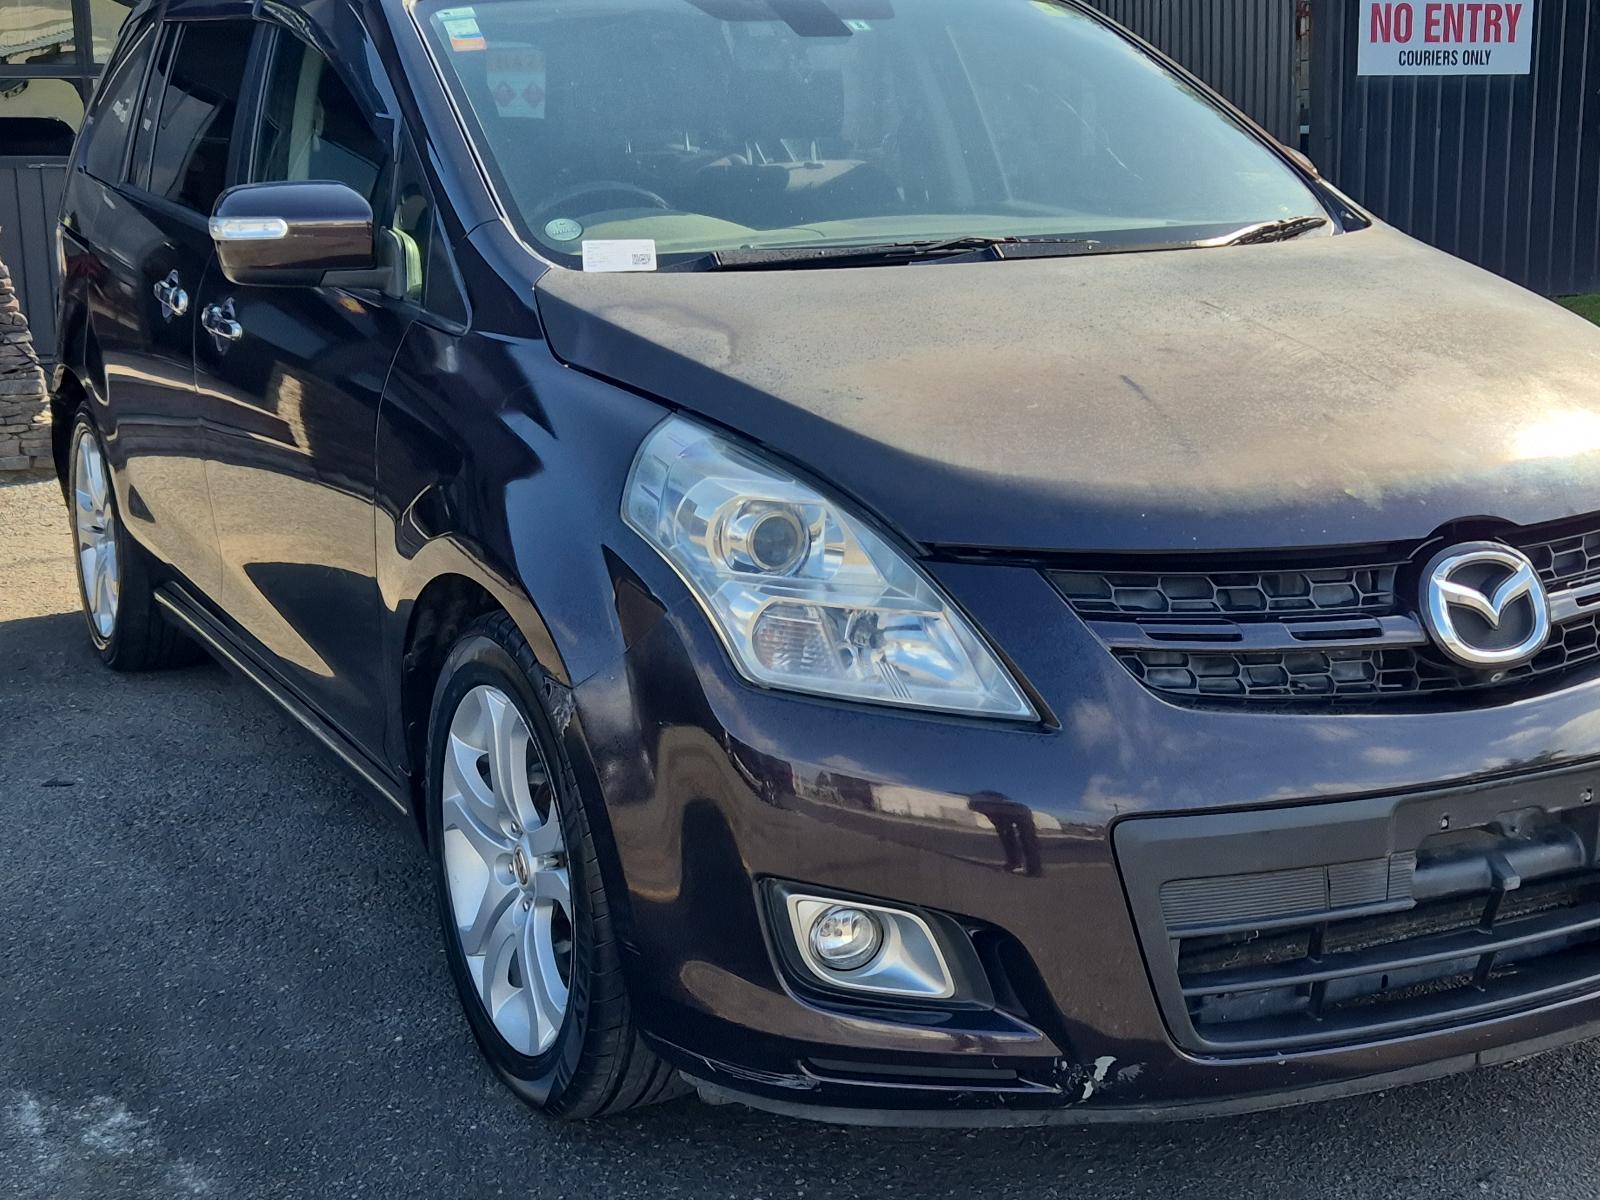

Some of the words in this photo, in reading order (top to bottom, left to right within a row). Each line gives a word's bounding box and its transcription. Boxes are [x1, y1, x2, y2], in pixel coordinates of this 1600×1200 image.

[1370, 3, 1413, 43] NO
[1424, 3, 1522, 43] ENTRY
[1398, 50, 1458, 66] COURIERS
[1462, 50, 1491, 66] ONLY
